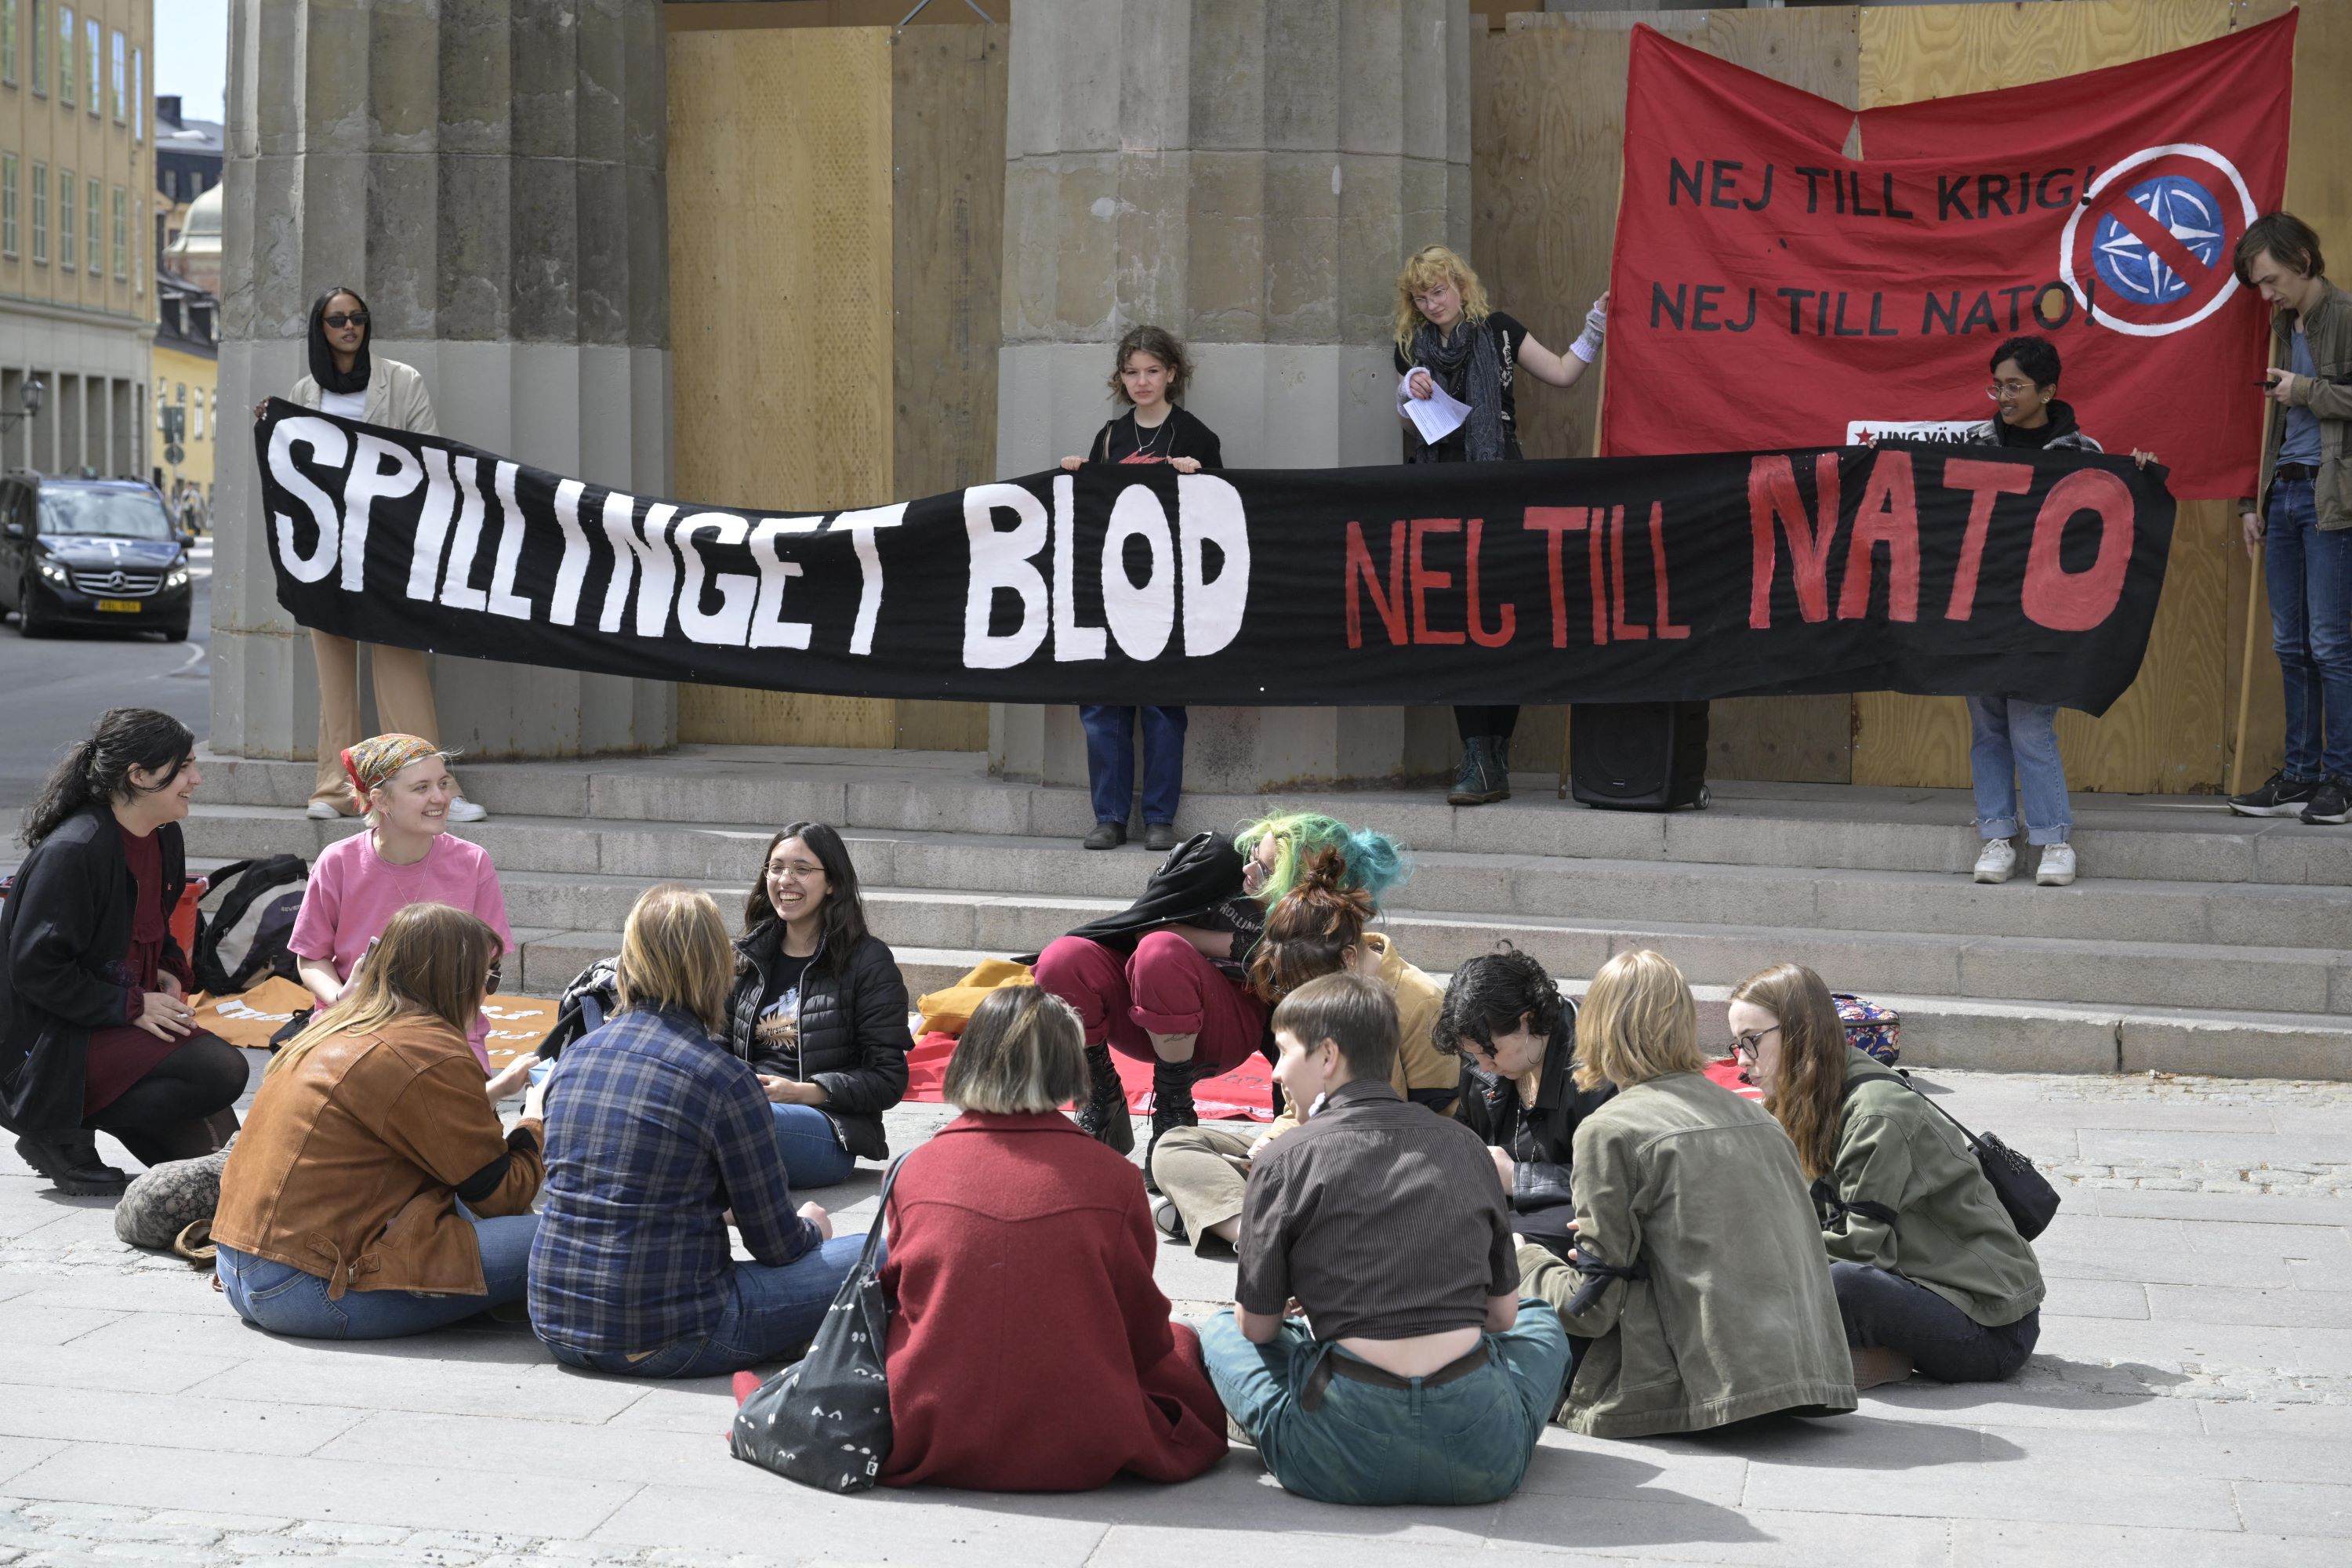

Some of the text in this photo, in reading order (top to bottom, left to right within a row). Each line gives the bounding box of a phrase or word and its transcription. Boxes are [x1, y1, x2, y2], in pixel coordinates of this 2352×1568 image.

[1668, 158, 2096, 221] NEJ TILL KRIG!
[1650, 278, 2096, 336] NEJ TILL NATO!
[268, 416, 532, 620] SPILL
[550, 478, 909, 655] INGET
[963, 474, 1250, 670] BLOD
[1523, 501, 1691, 648] TILL
[1748, 451, 2135, 632] NATO
